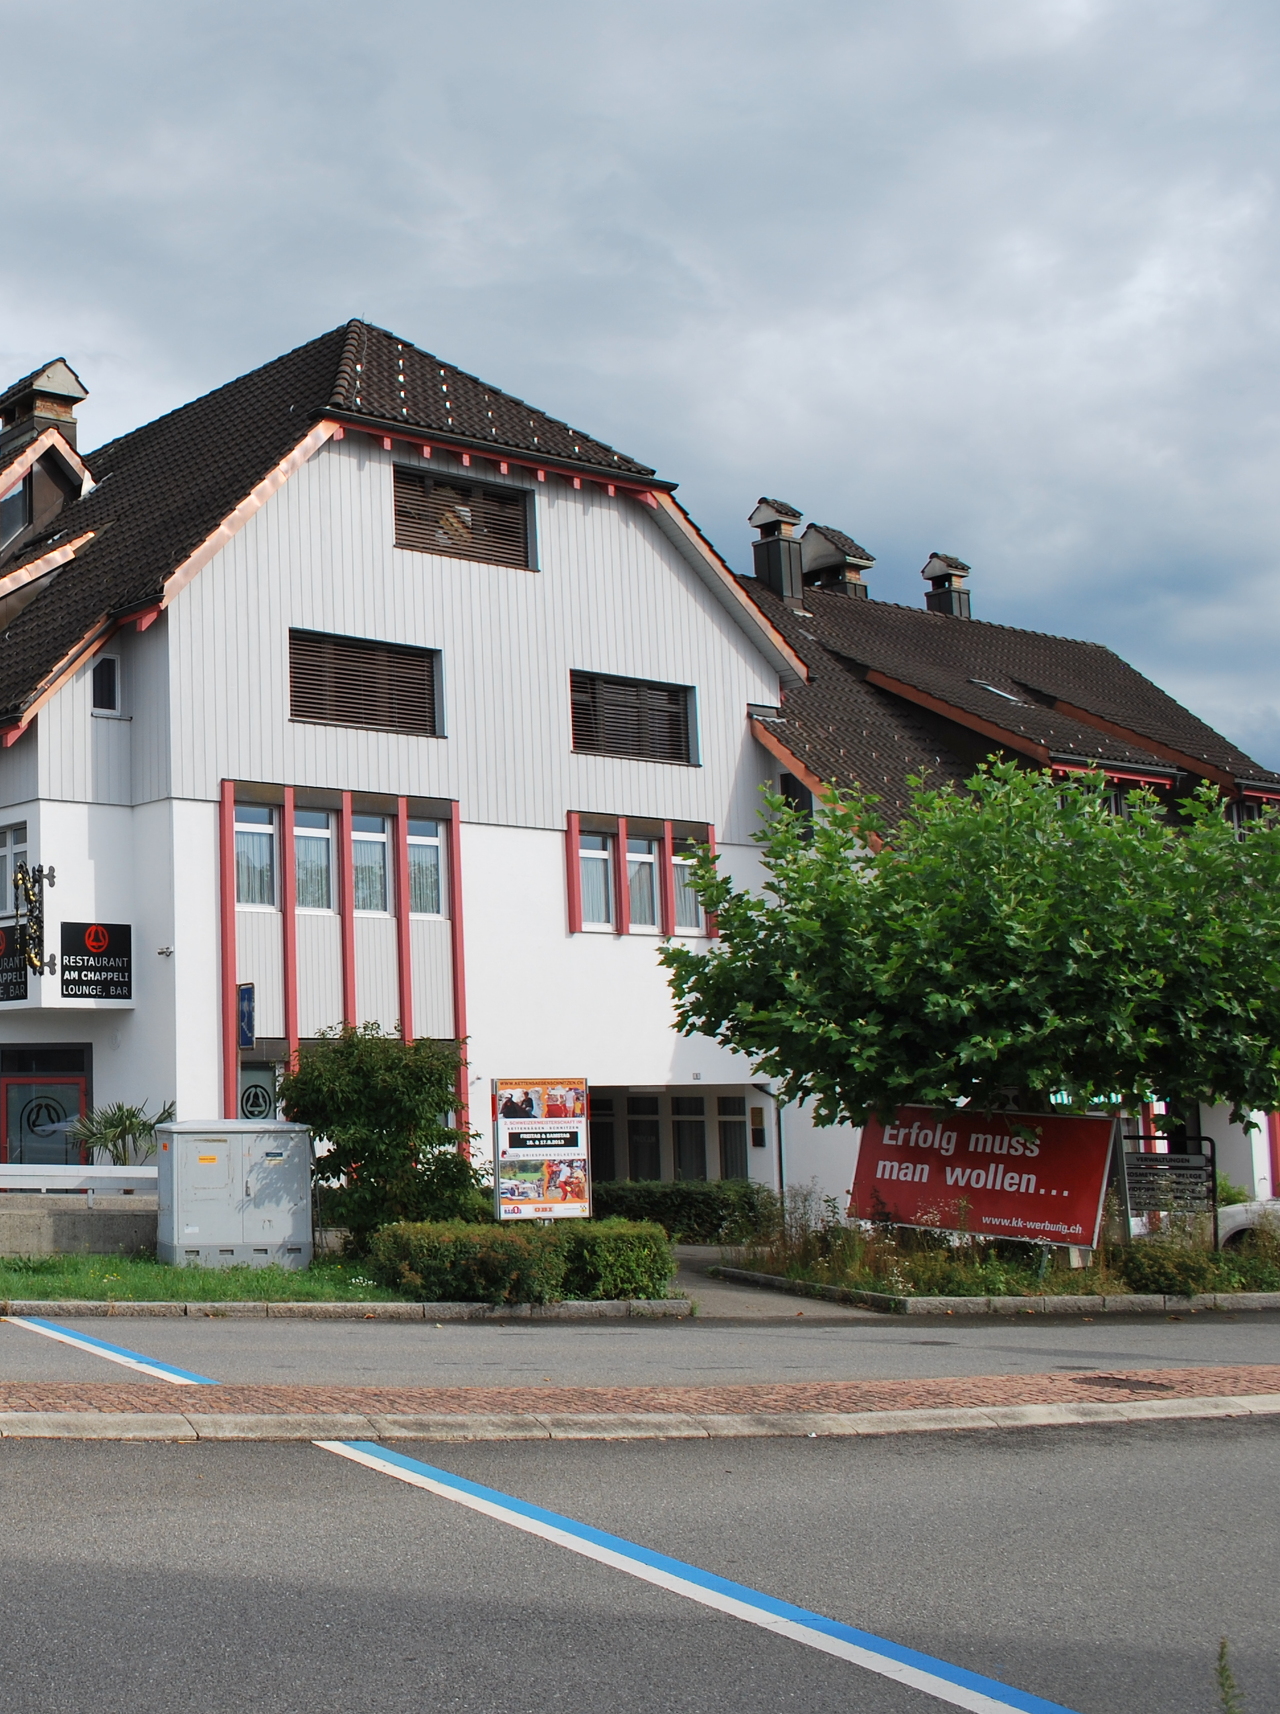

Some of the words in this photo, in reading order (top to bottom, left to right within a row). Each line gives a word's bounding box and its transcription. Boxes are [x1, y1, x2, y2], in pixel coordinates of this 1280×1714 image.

[63, 955, 129, 968] RESTAURANT
[63, 971, 79, 980] AM
[81, 971, 129, 981] CHAPPELI
[10, 985, 26, 997] BAR
[63, 985, 106, 997] LOUNGE,
[110, 986, 129, 996] BAR
[882, 1120, 957, 1156] Erfolg
[968, 1133, 1041, 1157] muss
[1136, 1156, 1190, 1164] VERWALTUNGEN
[876, 1160, 930, 1183] man
[982, 1216, 1083, 1234] www.kk-werbung.ch
